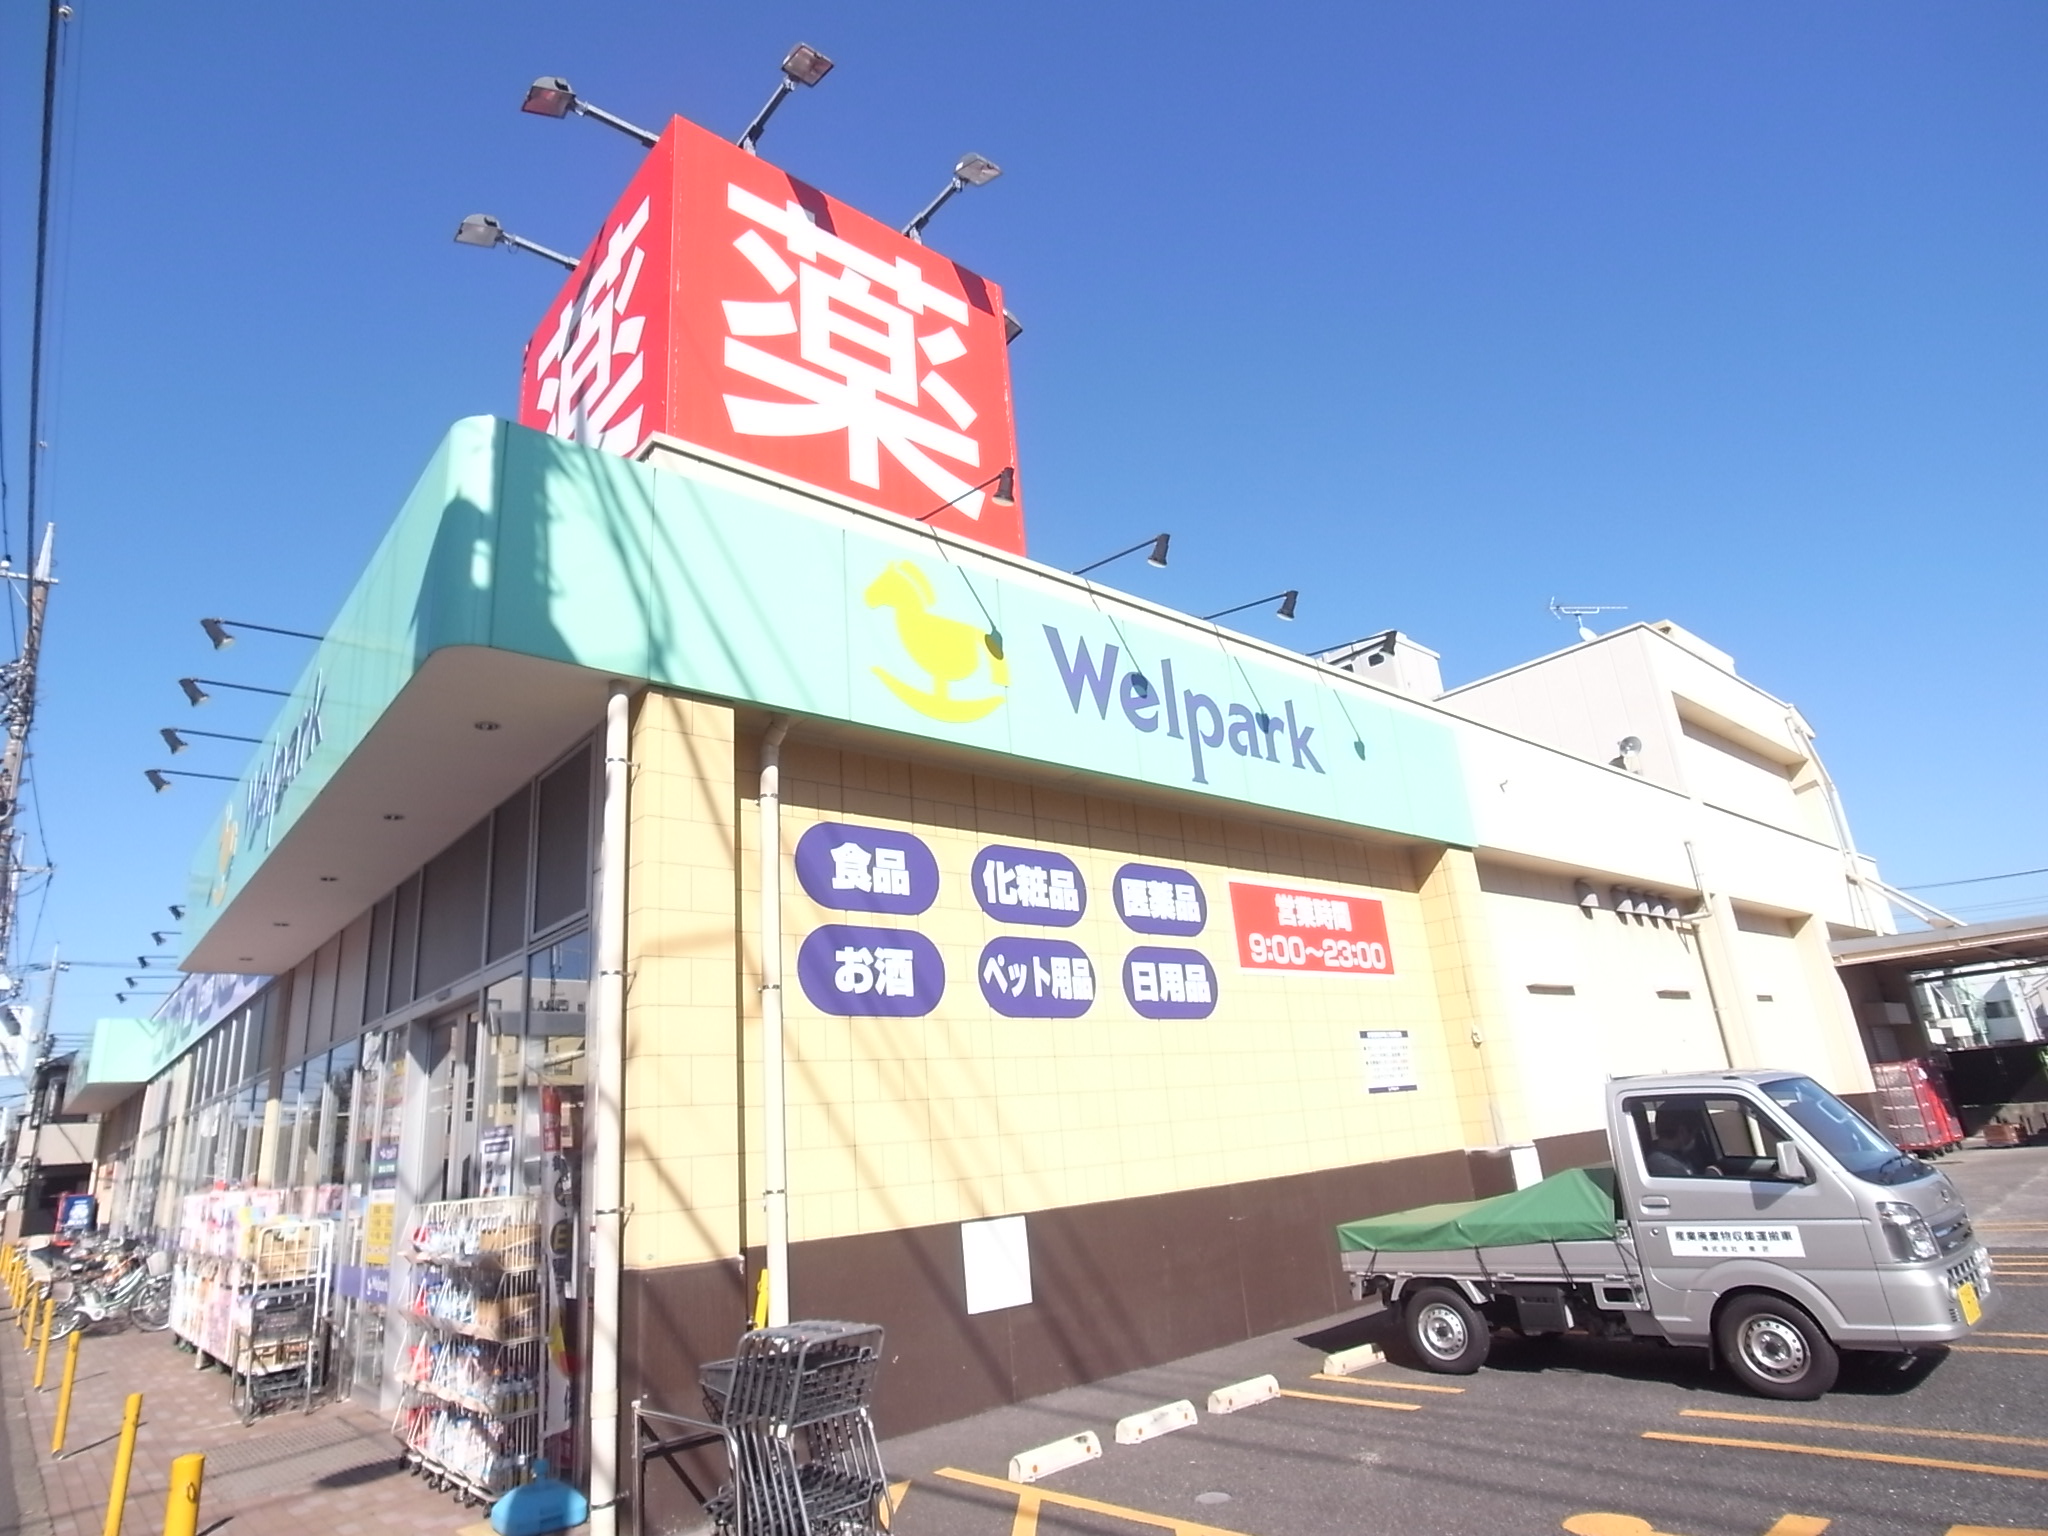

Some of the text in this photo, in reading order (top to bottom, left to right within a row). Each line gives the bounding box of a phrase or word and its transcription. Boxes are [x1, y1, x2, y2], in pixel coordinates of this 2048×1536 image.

[537, 194, 651, 460] 薬
[722, 181, 986, 521] 薬
[1042, 624, 1326, 785] Welpark
[244, 668, 326, 852] Welpark
[830, 842, 910, 896] 食品
[982, 859, 1080, 912] 化粧品
[1120, 877, 1201, 922] 医薬品
[1274, 893, 1353, 932] 営業時間
[834, 946, 914, 997] お酒
[983, 954, 1094, 1000] ペット用品
[1131, 961, 1211, 1003] 日用品
